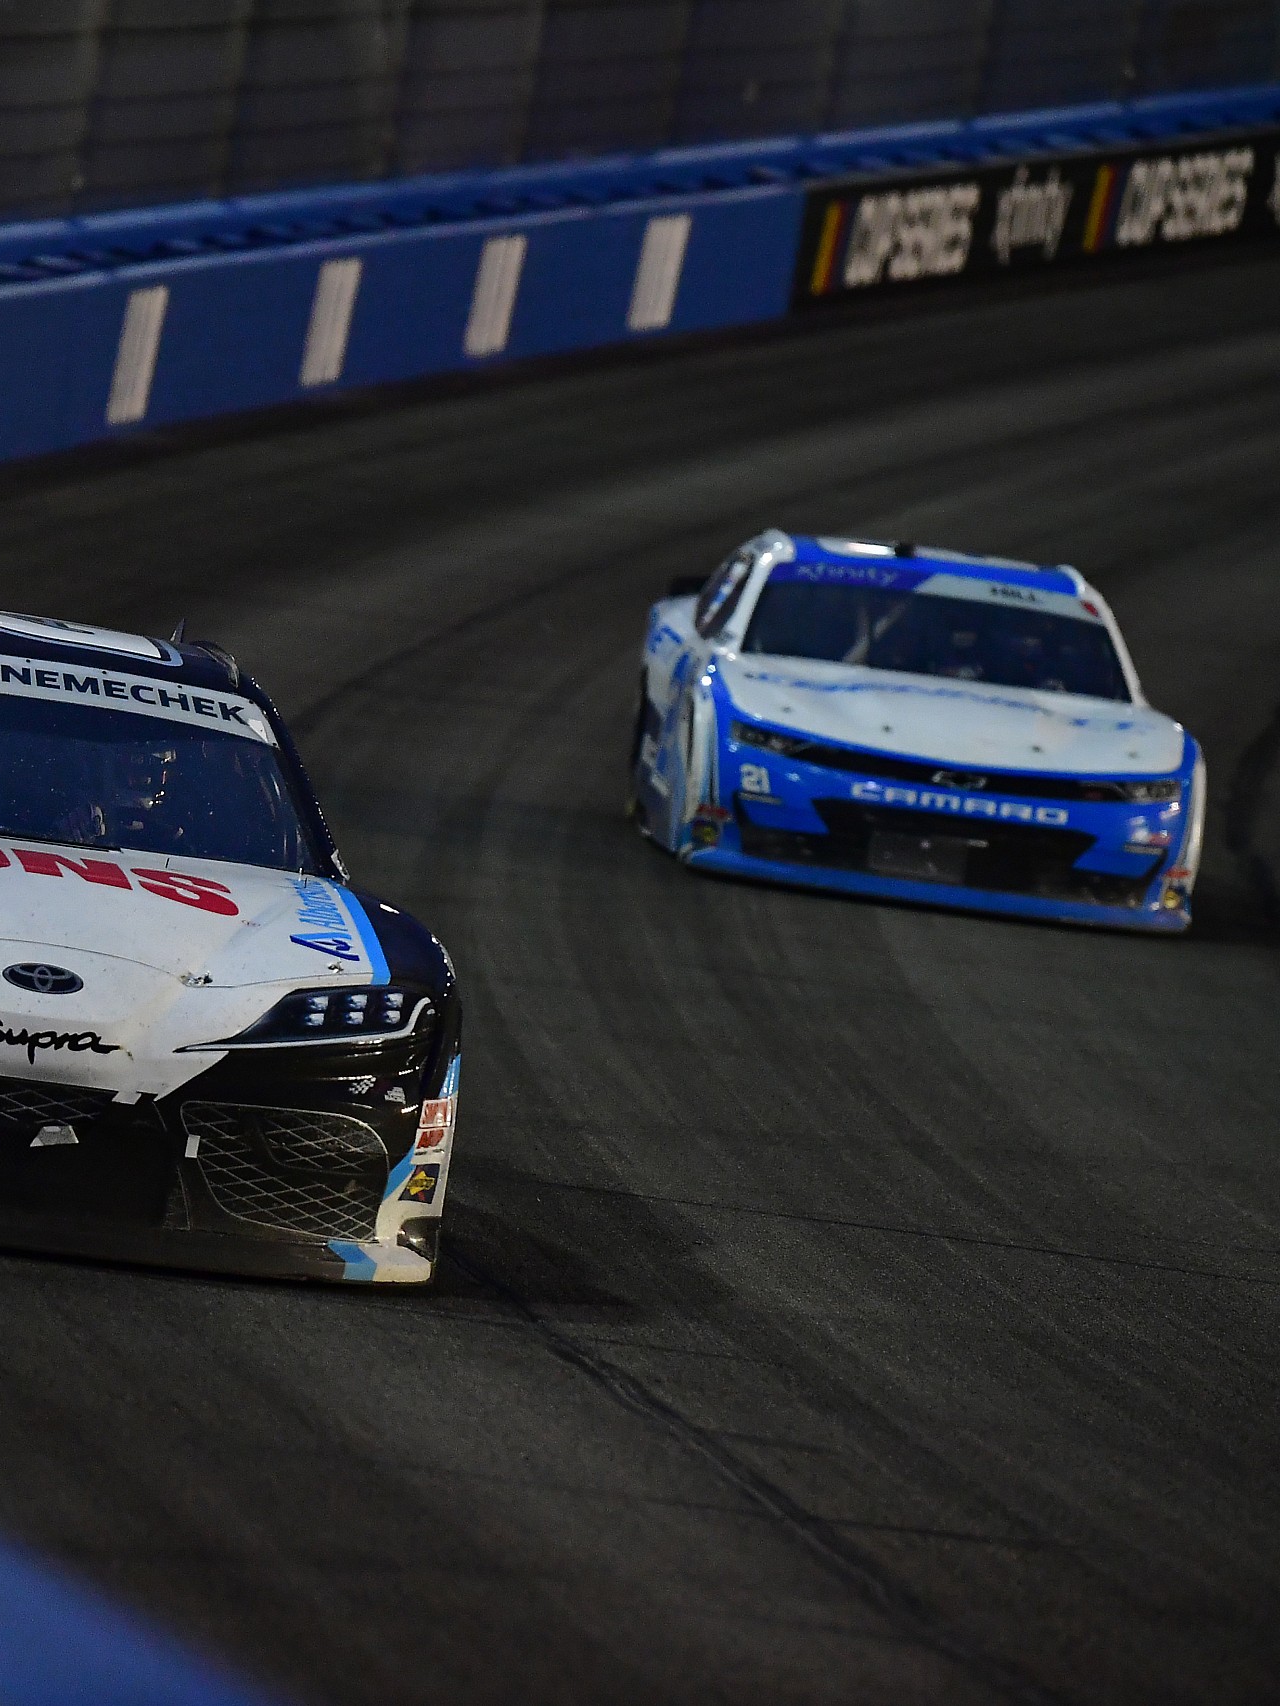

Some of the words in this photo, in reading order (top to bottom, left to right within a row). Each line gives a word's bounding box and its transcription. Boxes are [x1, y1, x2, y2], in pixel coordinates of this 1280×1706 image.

[0, 664, 247, 725] NEMECHEK
[740, 764, 770, 793] 21
[851, 782, 1069, 827] CAMARO
